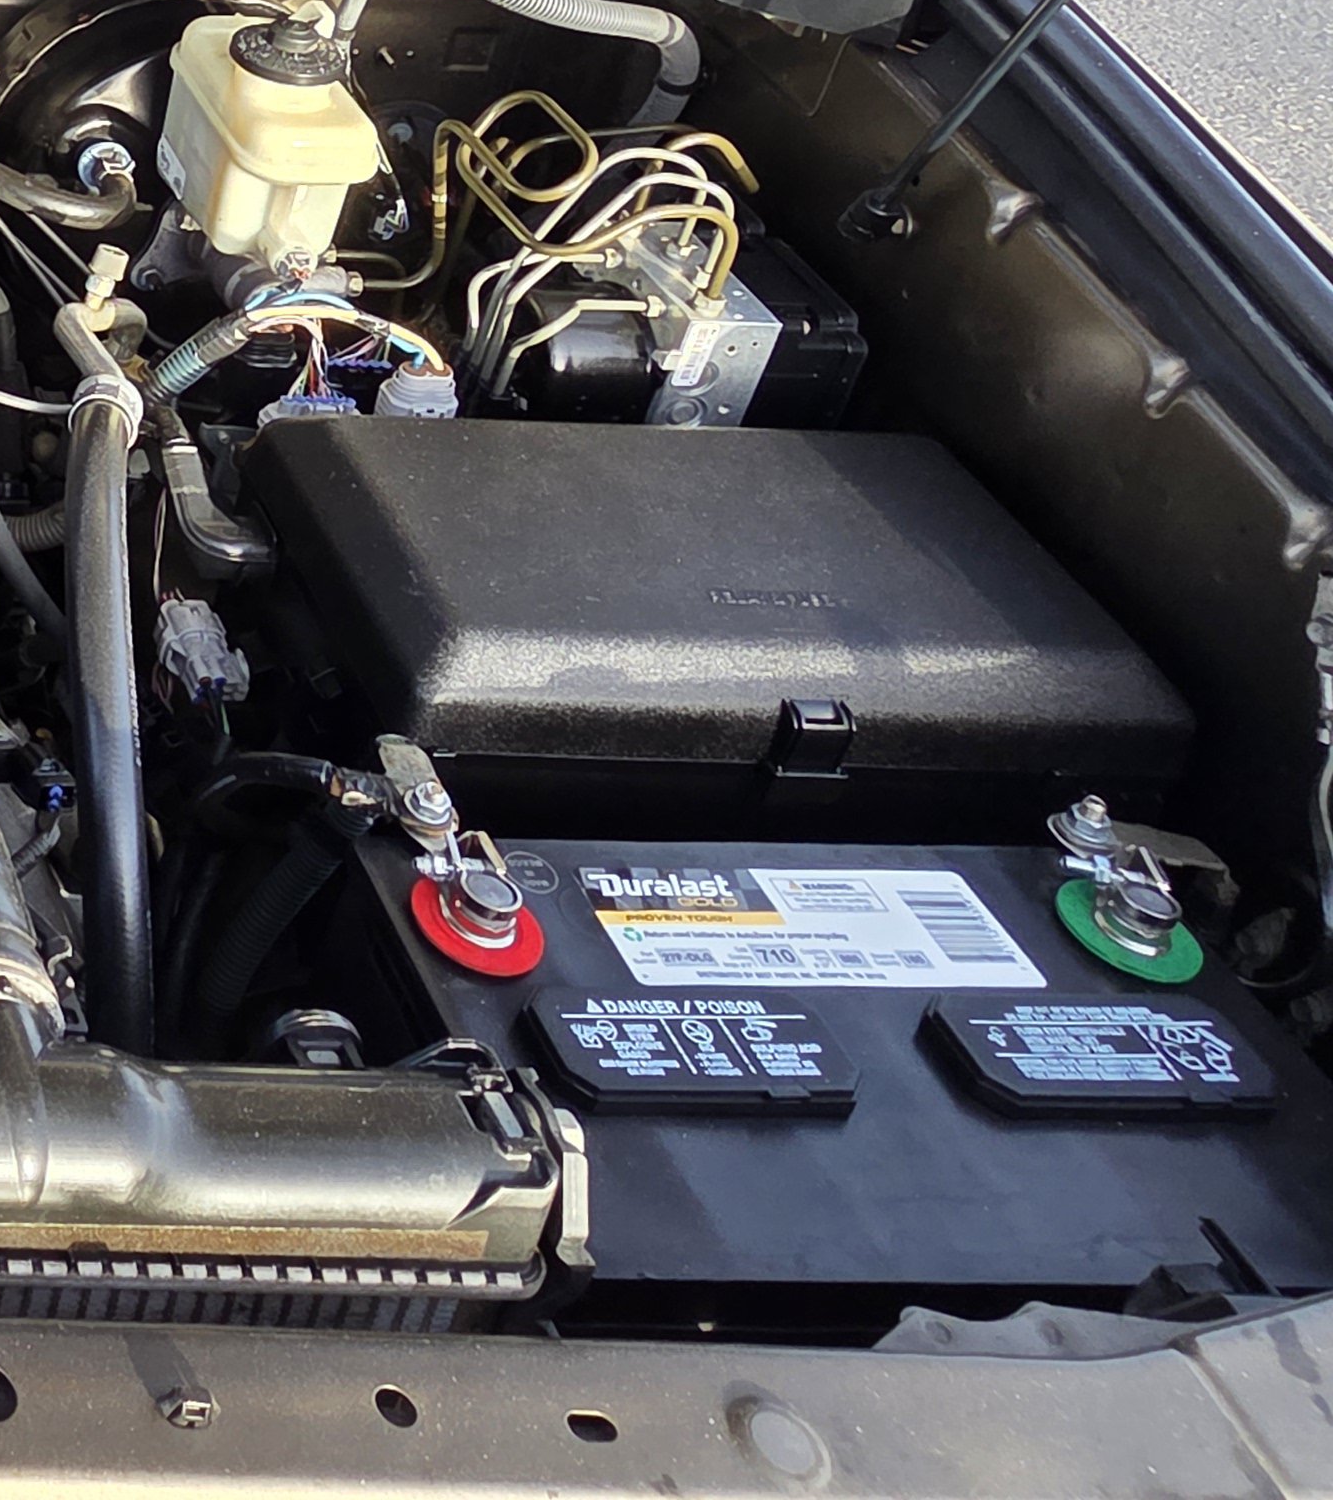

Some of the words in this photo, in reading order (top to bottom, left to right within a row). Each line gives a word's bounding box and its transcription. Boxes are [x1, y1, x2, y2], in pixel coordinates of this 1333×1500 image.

[587, 873, 734, 898] Duralast
[677, 897, 739, 908] GOLD
[626, 913, 683, 923] PROVEN
[687, 914, 734, 923] TOUGH
[756, 948, 796, 965] 710
[603, 1000, 680, 1015] DANGER
[697, 1000, 767, 1015] POISON
